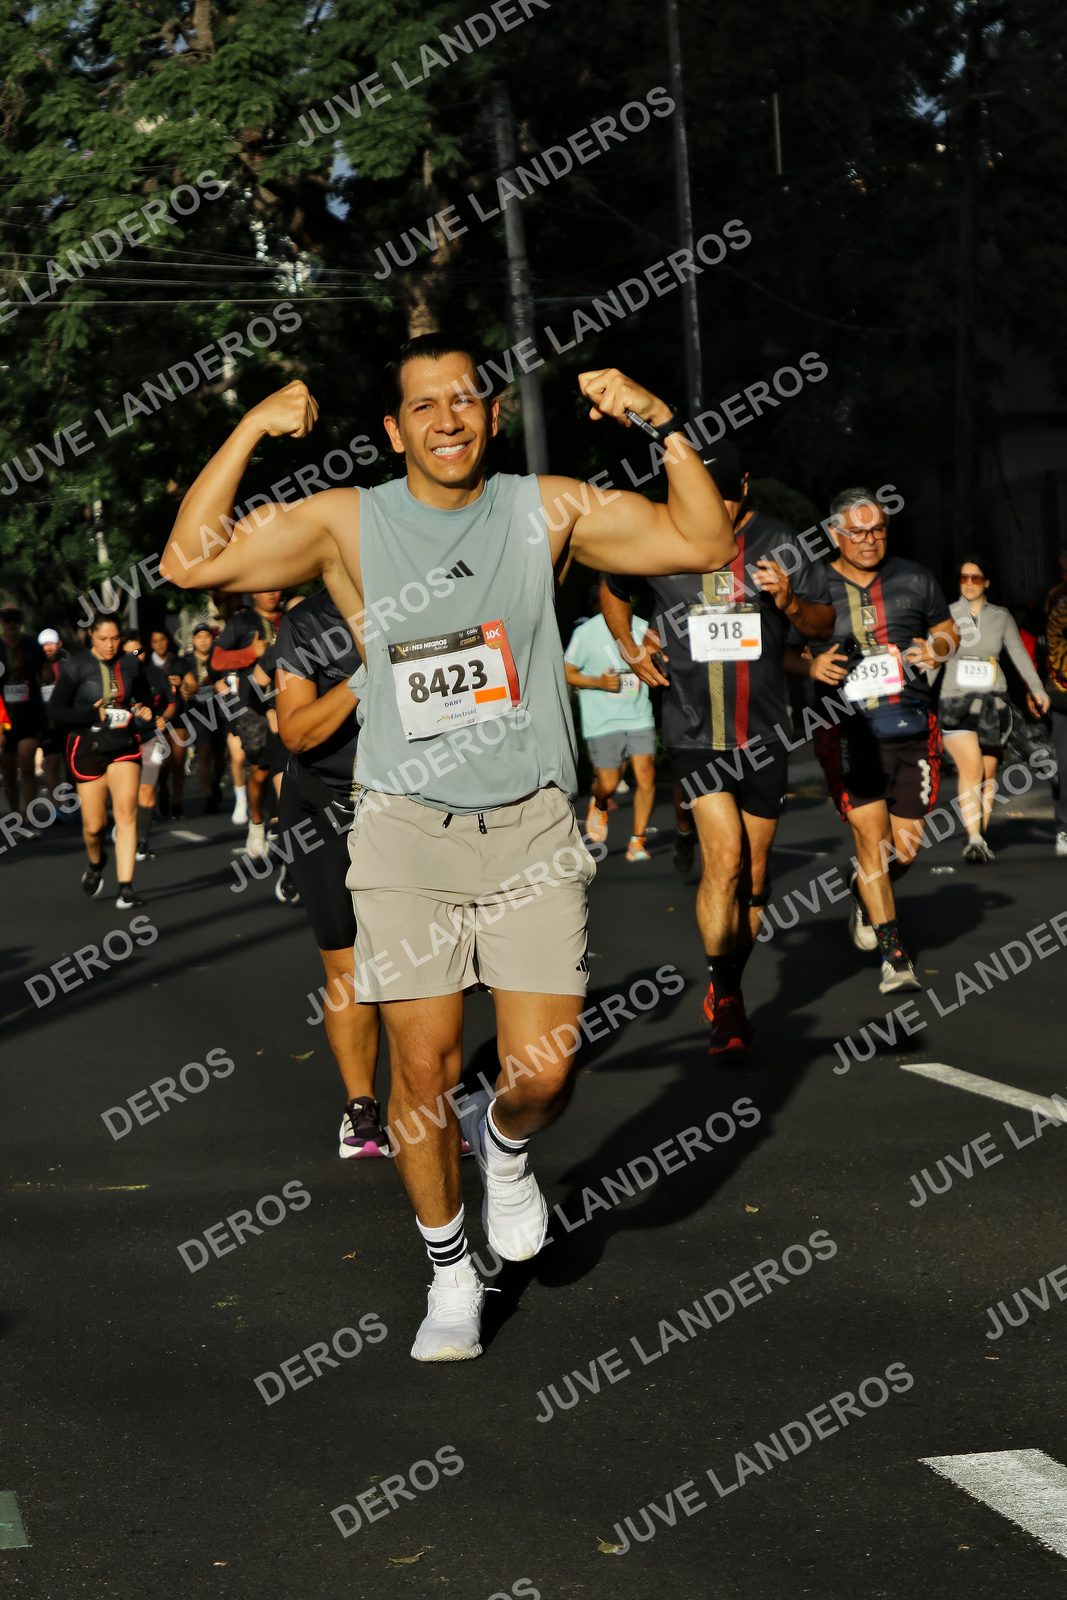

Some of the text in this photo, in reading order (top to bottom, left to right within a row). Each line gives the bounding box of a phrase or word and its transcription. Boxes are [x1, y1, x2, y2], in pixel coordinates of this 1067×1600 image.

[708, 621, 743, 640] 918
[423, 638, 448, 649] NEGROS
[408, 659, 488, 703] 8423
[444, 699, 462, 707] DANY
